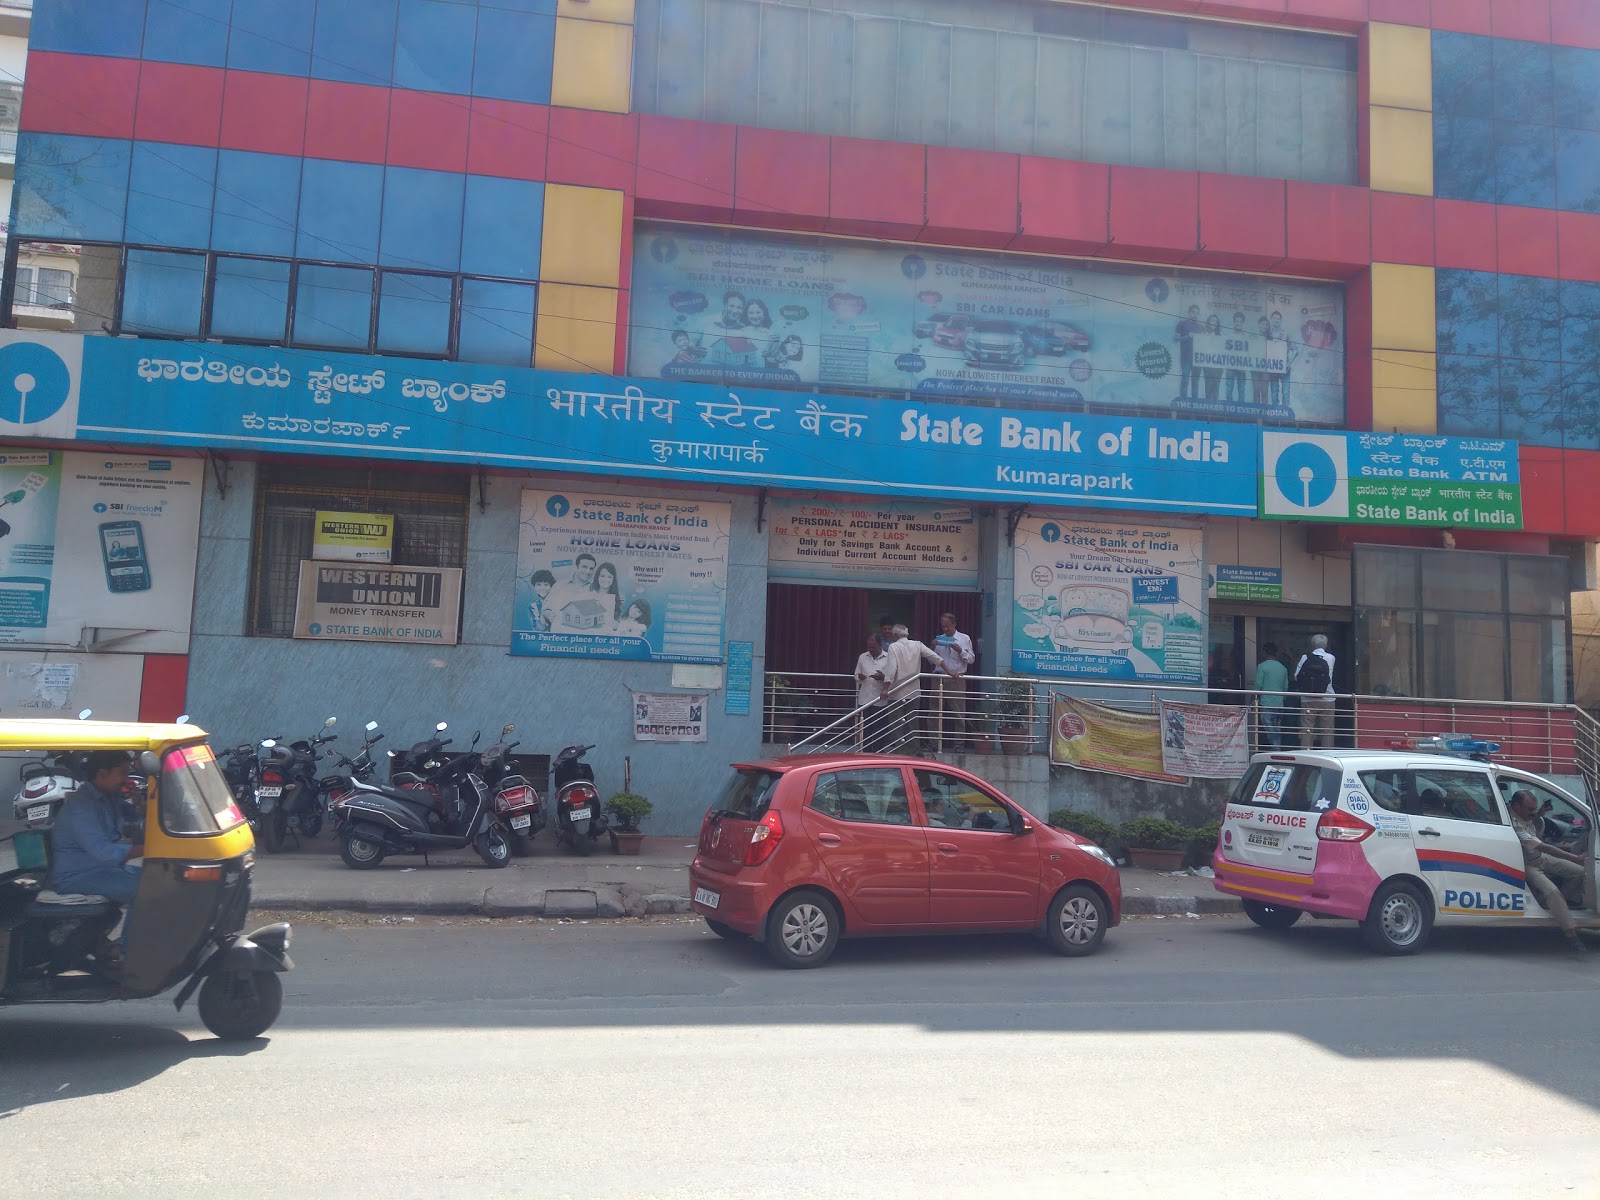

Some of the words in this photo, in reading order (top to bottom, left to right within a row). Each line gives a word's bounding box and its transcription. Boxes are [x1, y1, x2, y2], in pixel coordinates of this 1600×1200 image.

[935, 263, 976, 279] State
[979, 267, 1014, 282] Bank
[1017, 269, 1034, 283] of
[1038, 271, 1073, 287] India
[956, 303, 976, 313] SBI
[980, 304, 1006, 315] CAR
[1009, 306, 1051, 318] LOANS
[1225, 339, 1249, 352] SBI
[1194, 352, 1254, 367] EDUCATIONAL
[1255, 358, 1284, 371] LOANS
[688, 368, 723, 377] BANKER
[737, 371, 764, 380] EVERY
[765, 373, 796, 382] INDIAN
[936, 368, 955, 377] NOW
[956, 370, 967, 378] AT
[968, 370, 1000, 381] LOWEST
[1002, 374, 1040, 384] INTEREST
[1041, 376, 1066, 385] RATES
[138, 356, 291, 389] ಭಾರತೀಯ
[308, 365, 386, 405] ಸ್ಟೇಟ್
[402, 377, 507, 413] ಬ್ಯಾಂಕ್
[547, 385, 681, 424] भारतीय
[696, 393, 781, 430] स्टेट
[795, 399, 868, 438] बैंक
[1176, 401, 1192, 409] THE
[1194, 402, 1224, 411] BANKER
[1237, 406, 1261, 415] EVERY
[1262, 408, 1289, 417] INDIAN
[241, 411, 411, 440] ಕುಮಾರಪಾರ್ಕ್
[900, 409, 984, 446] State
[1000, 417, 1083, 454] Bank
[1098, 426, 1133, 457] of
[1148, 427, 1230, 463] India
[1359, 433, 1395, 450] ಸ್ಟೇಟ್
[1403, 437, 1448, 453] ಬ್ಯಾಂಕ್
[1370, 451, 1402, 464] स्टेट
[1460, 457, 1506, 470] ए.टी.एम
[996, 465, 1134, 492] Kumarapark
[1361, 465, 1404, 477] State
[1408, 467, 1450, 480] Bank
[1461, 471, 1508, 482] ATM
[1356, 485, 1388, 497] ಭಾರತೀಯ
[1439, 488, 1471, 500] भारतीय
[1475, 489, 1493, 500] स्टेट
[1497, 489, 1513, 501] बैंक
[573, 508, 612, 521] State
[616, 511, 649, 524] Bank
[653, 514, 670, 525] of
[673, 515, 708, 528] India
[1356, 504, 1401, 520] State
[1406, 506, 1449, 522] Bank
[1453, 507, 1470, 523] of
[1475, 508, 1516, 524] India
[324, 521, 360, 529] WESTERN
[362, 524, 384, 535] WU
[791, 516, 843, 528] PERSONAL
[849, 520, 899, 530] ACCIDENT
[905, 523, 962, 534] INSURANCE
[541, 526, 577, 535] Experience
[597, 528, 613, 536] Loan
[614, 529, 630, 537] from
[630, 531, 652, 539] India's
[653, 533, 669, 541] Most
[670, 534, 693, 542] trusted
[570, 535, 621, 548] HOME
[625, 539, 681, 552] LOANS
[799, 537, 818, 548] Only
[823, 539, 836, 547] for
[841, 540, 874, 550] Savings
[879, 541, 900, 550] Bank
[905, 543, 940, 552] Account
[945, 545, 952, 553] &
[1063, 534, 1096, 546] State
[1100, 537, 1128, 548] Bank
[1132, 539, 1146, 549] of
[1149, 540, 1179, 551] India
[556, 545, 578, 553] NOW
[578, 546, 589, 554] AT
[590, 547, 624, 556] LOWEST
[626, 550, 665, 558] INTEREST
[667, 552, 692, 560] RATES
[797, 547, 839, 558] Individual
[844, 549, 877, 559] Current
[882, 551, 917, 561] Account
[922, 554, 954, 563] Holders
[1055, 561, 1079, 570] SBI
[1083, 562, 1112, 573] CAR
[1116, 564, 1163, 575] LOANS
[321, 569, 417, 587] WESTERN
[1138, 578, 1170, 586] LOWEST
[352, 589, 416, 605] UNION
[329, 606, 368, 616] MONEY
[370, 608, 425, 619] TRANSFER
[326, 624, 359, 635] STATE
[362, 626, 393, 637] BANK
[397, 627, 411, 638] OF
[414, 628, 443, 639] INDIA
[519, 632, 536, 641] The
[538, 633, 569, 642] Perfect
[570, 635, 593, 646] place
[595, 636, 607, 644] for
[609, 636, 620, 645] all
[622, 639, 642, 647] your
[540, 643, 588, 654] Financial
[590, 645, 620, 655] needs
[1018, 651, 1033, 659] The
[1034, 653, 1061, 661] Perfect
[1062, 655, 1083, 664] place
[1085, 655, 1096, 663] for
[1097, 656, 1108, 664] all
[1109, 658, 1127, 666] your
[1036, 662, 1079, 672] Financial
[1080, 664, 1108, 674] needs
[1350, 802, 1367, 811] 100
[1266, 814, 1307, 829] POLICE
[1444, 889, 1525, 912] POLICE
